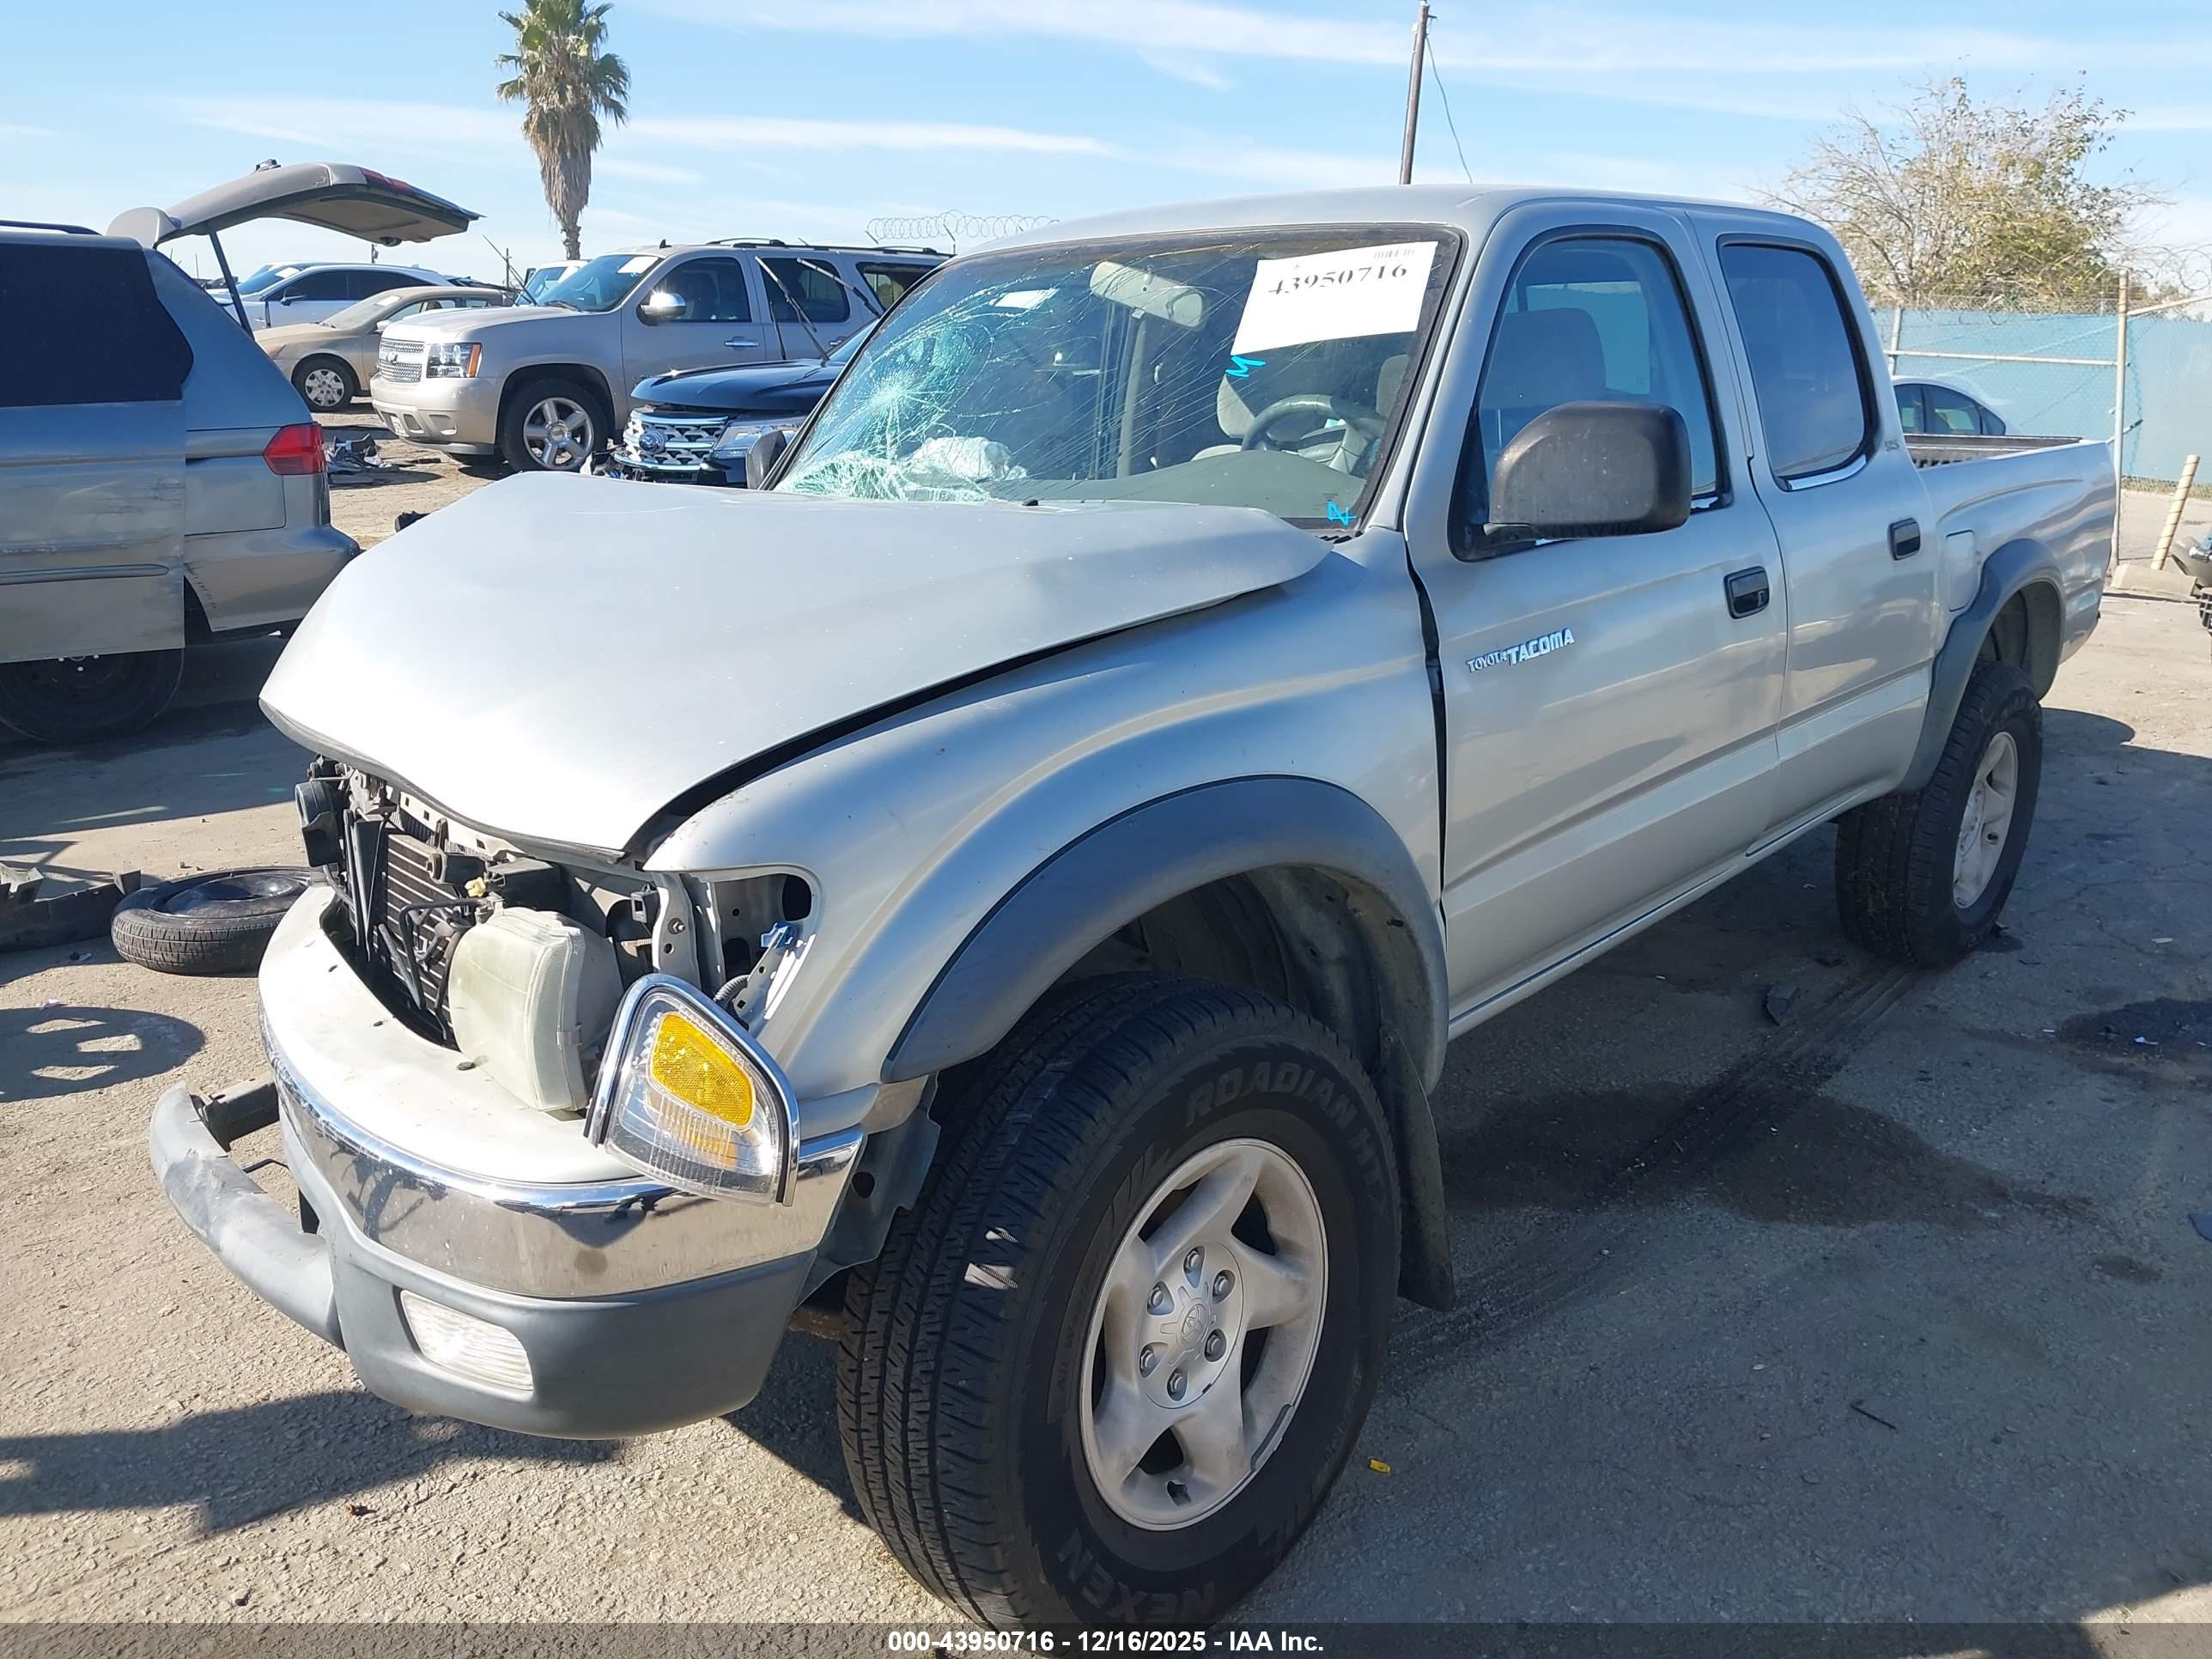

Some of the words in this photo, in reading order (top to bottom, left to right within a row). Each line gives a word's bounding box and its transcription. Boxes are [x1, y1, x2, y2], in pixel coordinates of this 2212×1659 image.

[1268, 264, 1407, 295] 43950716
[1467, 651, 1508, 672] TOYOTA
[1507, 629, 1575, 665] TACOMA
[1184, 1060, 1358, 1131] ROADIAN
[1056, 1528, 1216, 1623] NEXEN
